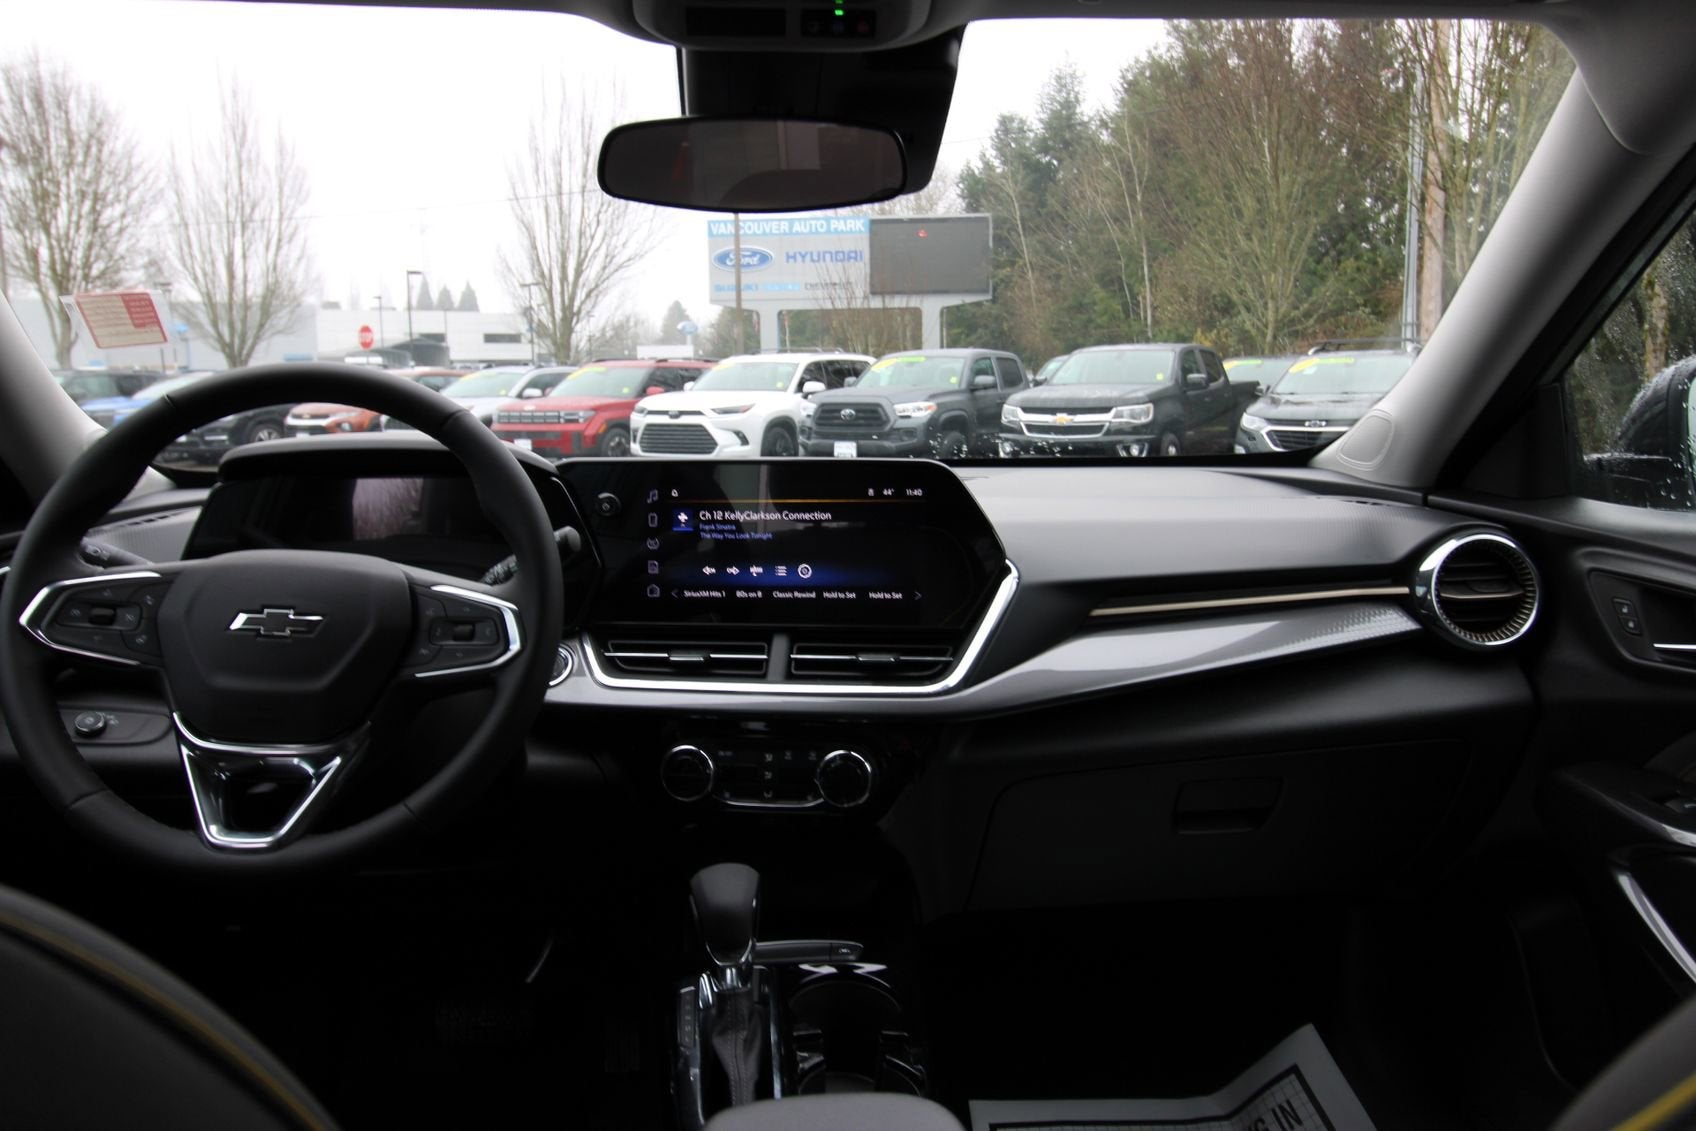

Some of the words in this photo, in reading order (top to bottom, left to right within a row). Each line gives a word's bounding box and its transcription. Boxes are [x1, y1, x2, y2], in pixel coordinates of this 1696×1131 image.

[710, 221, 789, 235] VANCOUVER
[793, 219, 827, 233] AUTO
[831, 218, 865, 232] PARK
[785, 249, 864, 264] HYUNDAI
[905, 488, 923, 497] 11:40
[699, 510, 713, 521] Ch
[713, 510, 723, 521] 12
[724, 510, 781, 523] KellyClarkson
[782, 510, 832, 521] Connection
[699, 523, 715, 531] Frank
[711, 532, 724, 541] Way
[725, 532, 736, 540] You
[736, 532, 750, 540] Look
[751, 532, 772, 541] Tonight
[773, 591, 793, 599] Classic
[793, 591, 816, 599] Rewind
[823, 591, 836, 599] Hold
[837, 591, 844, 599] to
[844, 591, 856, 599] Set
[869, 591, 882, 599] Hold
[883, 591, 890, 599] to
[890, 591, 903, 599] Set
[1271, 1099, 1303, 1131] IN
